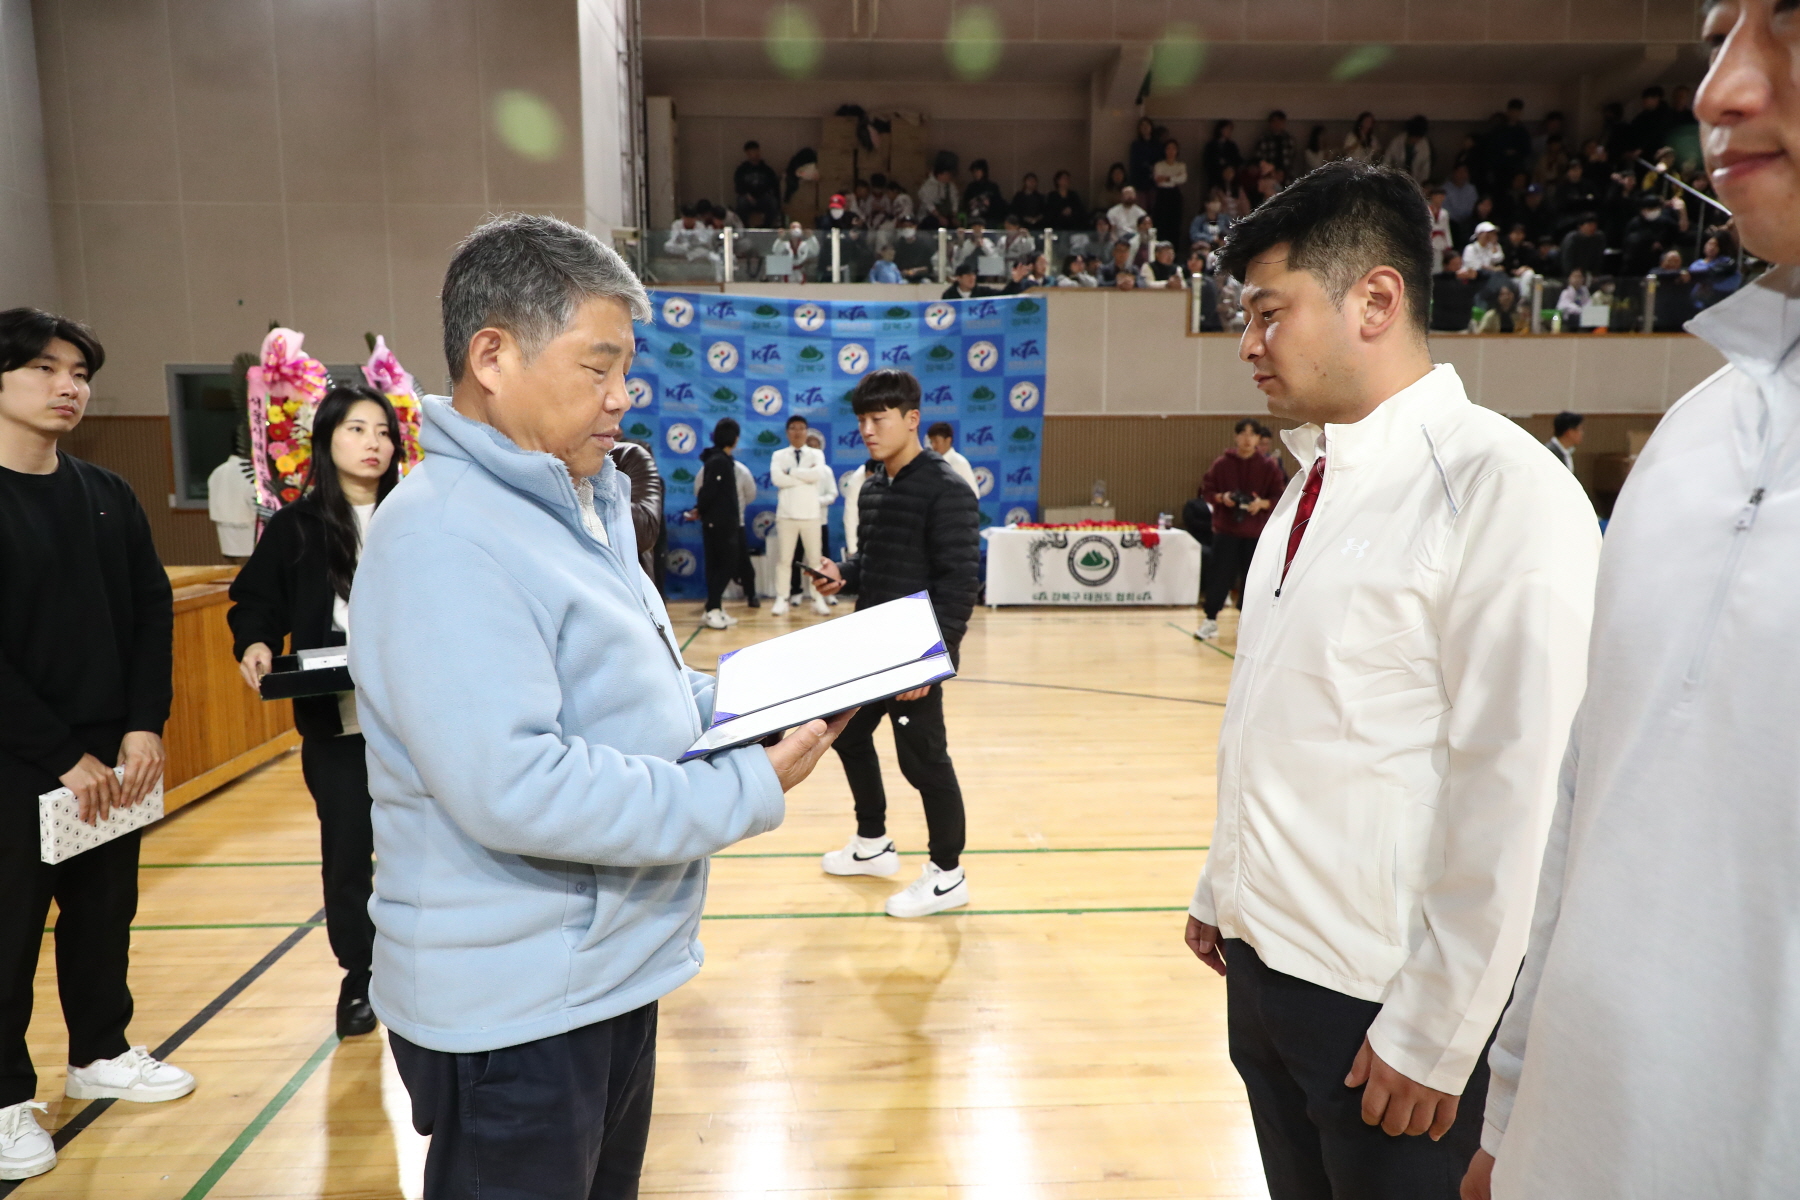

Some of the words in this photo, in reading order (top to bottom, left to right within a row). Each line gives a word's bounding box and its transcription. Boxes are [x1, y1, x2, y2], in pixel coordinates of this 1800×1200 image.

[706, 301, 737, 319] KTA
[838, 305, 869, 321] KTA
[968, 300, 998, 319] KTA
[751, 343, 782, 363] KTA
[881, 344, 911, 364] KTA
[1010, 339, 1040, 360] KTA
[665, 382, 695, 402] KTA
[795, 387, 825, 406] KTA
[924, 385, 954, 404] KTA
[966, 425, 995, 446] KTA
[1006, 465, 1033, 485] KTA
[1051, 591, 1081, 602] 강북구
[1083, 591, 1113, 602] 태권도
[1116, 591, 1135, 602] 협회
